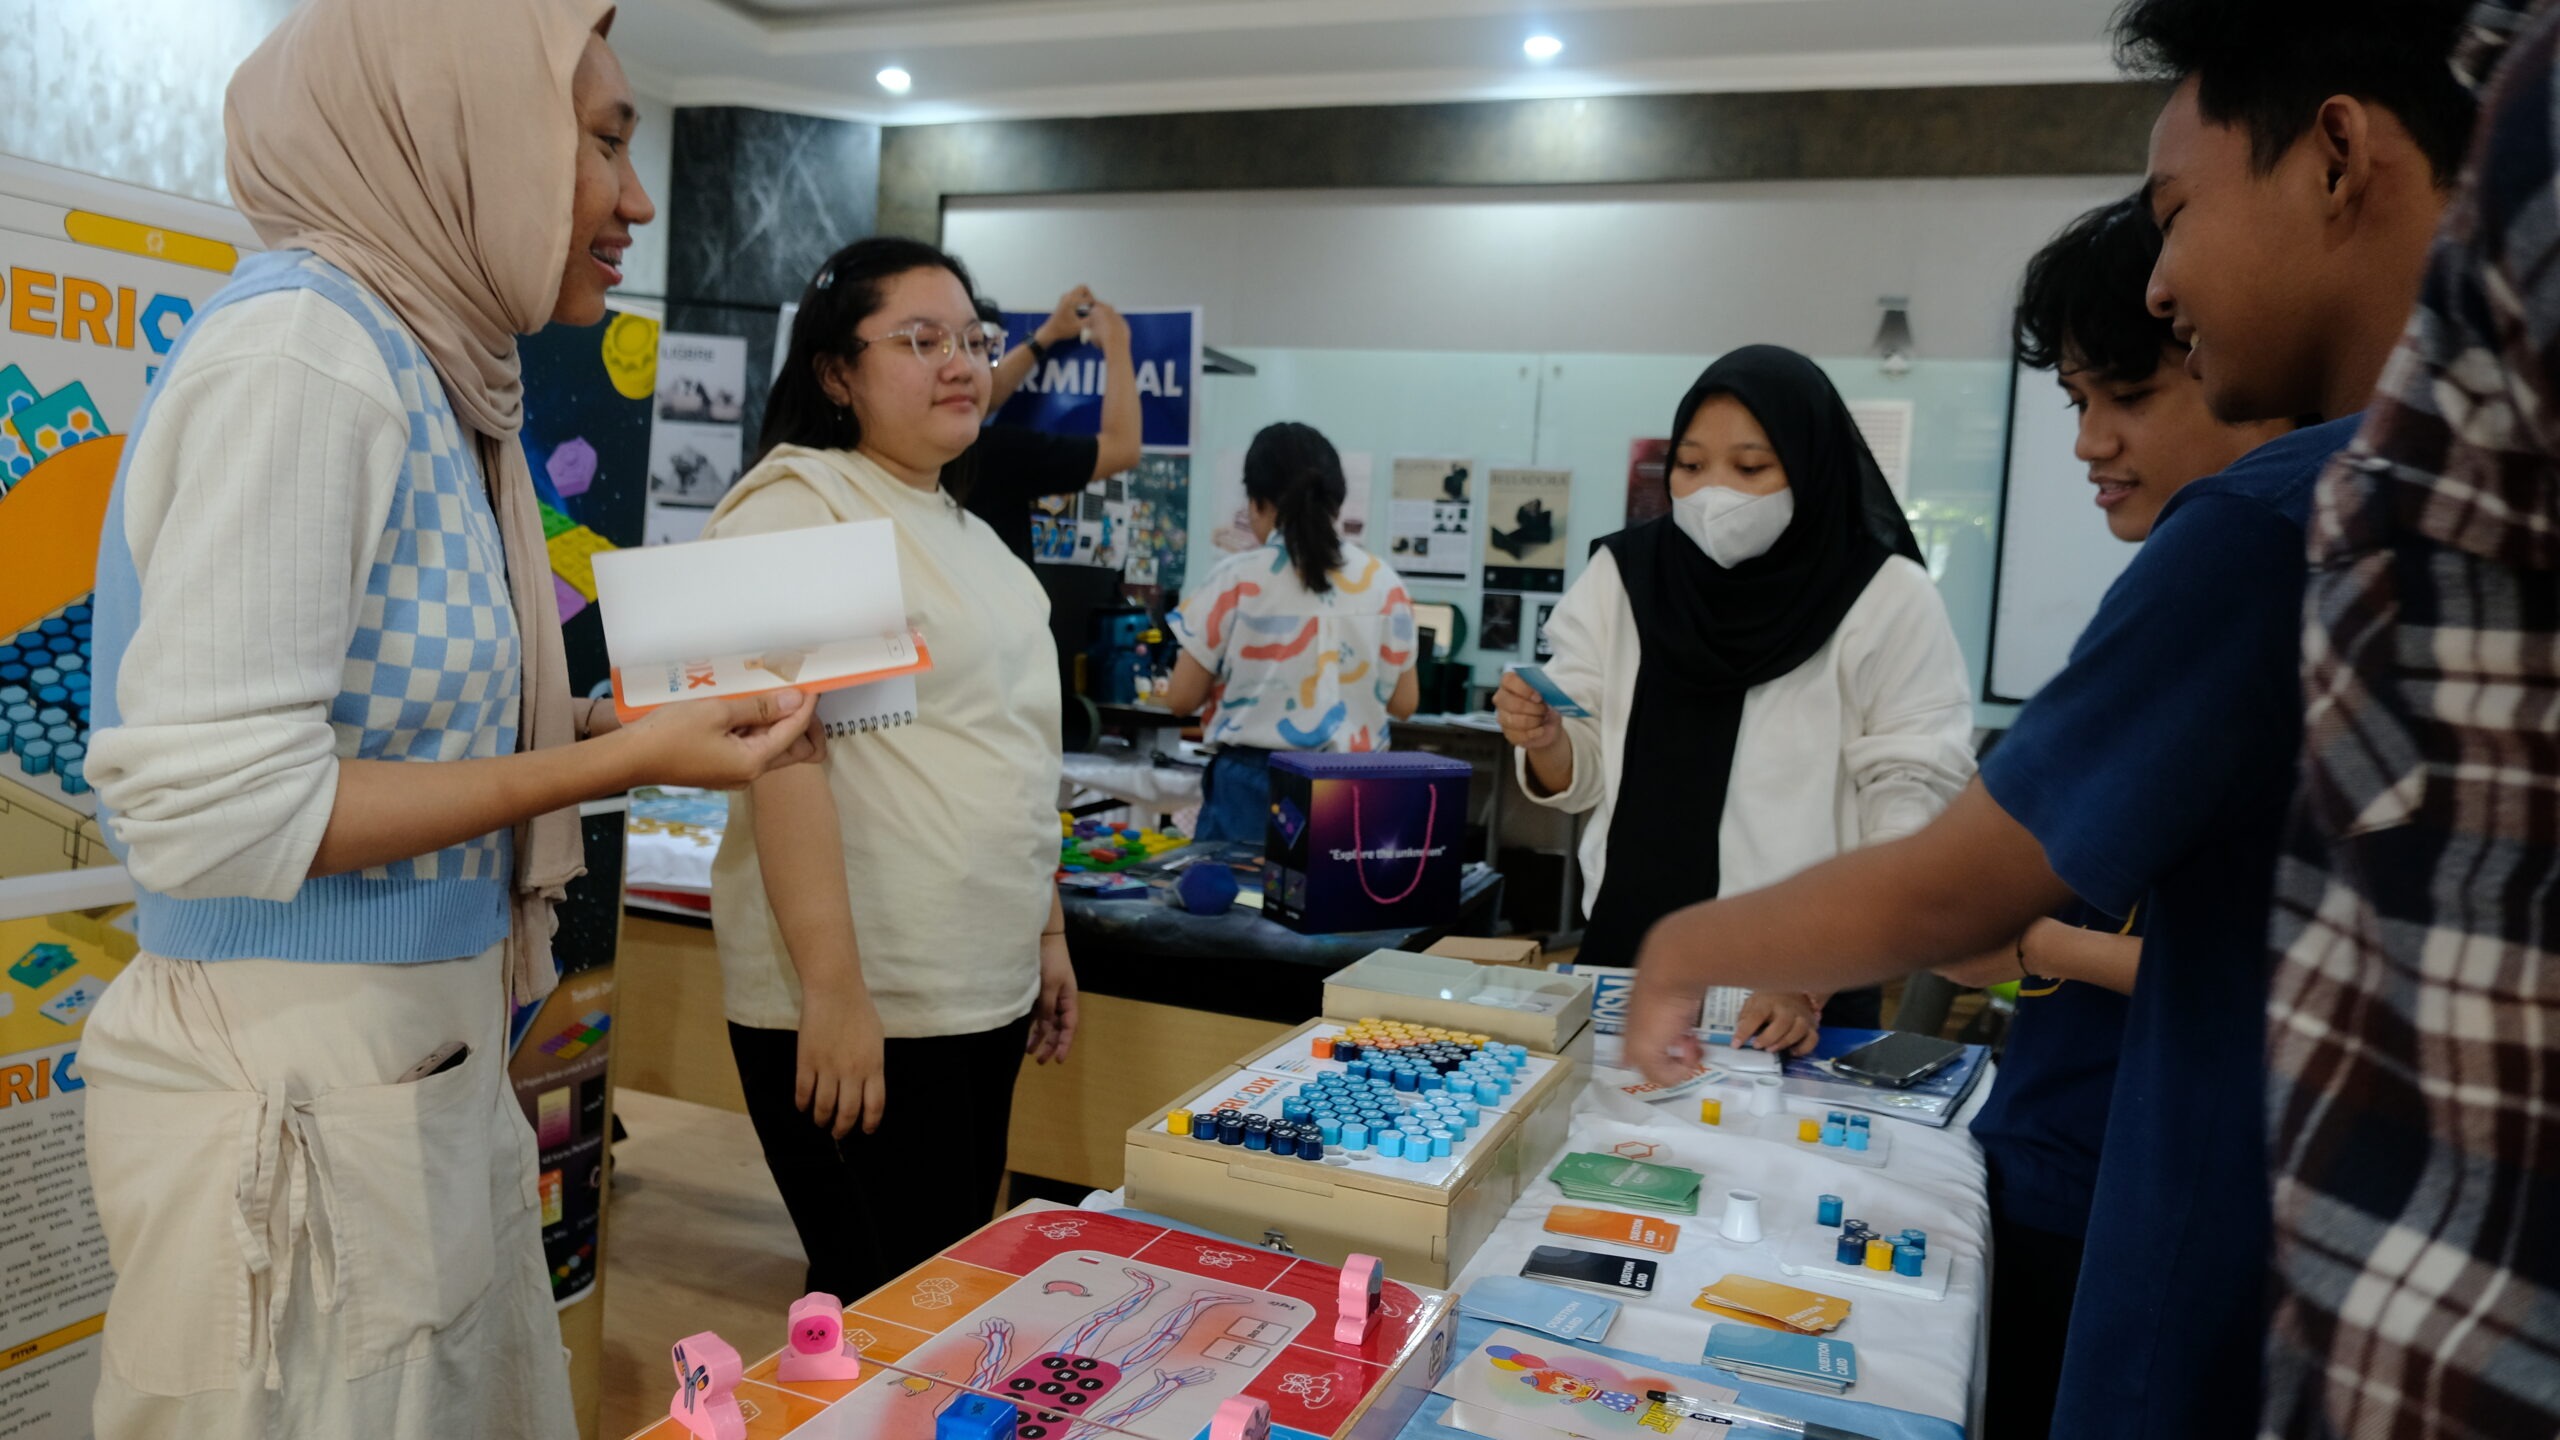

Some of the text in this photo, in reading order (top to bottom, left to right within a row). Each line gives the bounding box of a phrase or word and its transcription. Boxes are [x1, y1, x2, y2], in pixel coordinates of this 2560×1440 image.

[0, 266, 194, 355] ERIO
[1619, 1260, 1637, 1286] QUESTION
[1635, 1272, 1650, 1289] CARD
[1545, 1301, 1582, 1329] QUESTION
[1561, 1316, 1584, 1334] CARD
[1818, 1341, 1833, 1373] QUESTION
[1836, 1357, 1850, 1377] CARD
